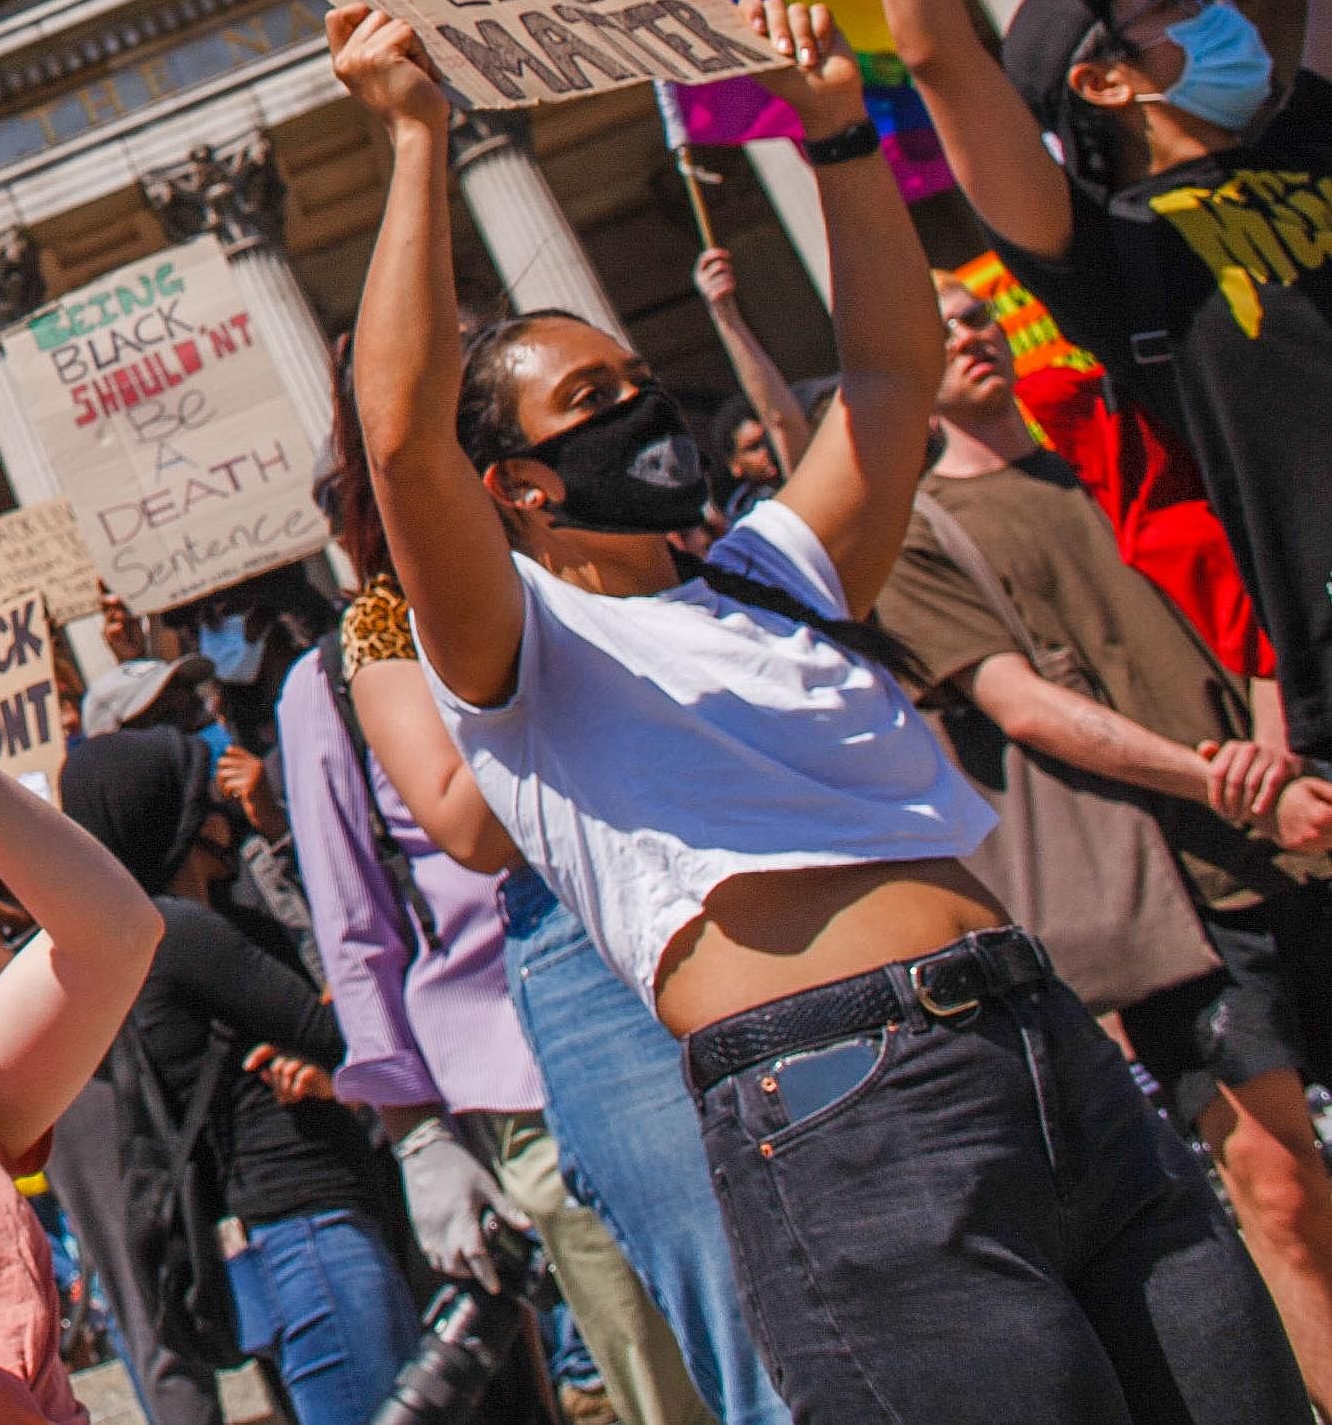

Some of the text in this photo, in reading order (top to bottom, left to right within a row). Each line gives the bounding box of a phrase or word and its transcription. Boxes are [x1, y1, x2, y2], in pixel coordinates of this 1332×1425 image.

[51, 300, 193, 384] BLACK
[97, 440, 291, 546] DEATH
[153, 440, 197, 484] A
